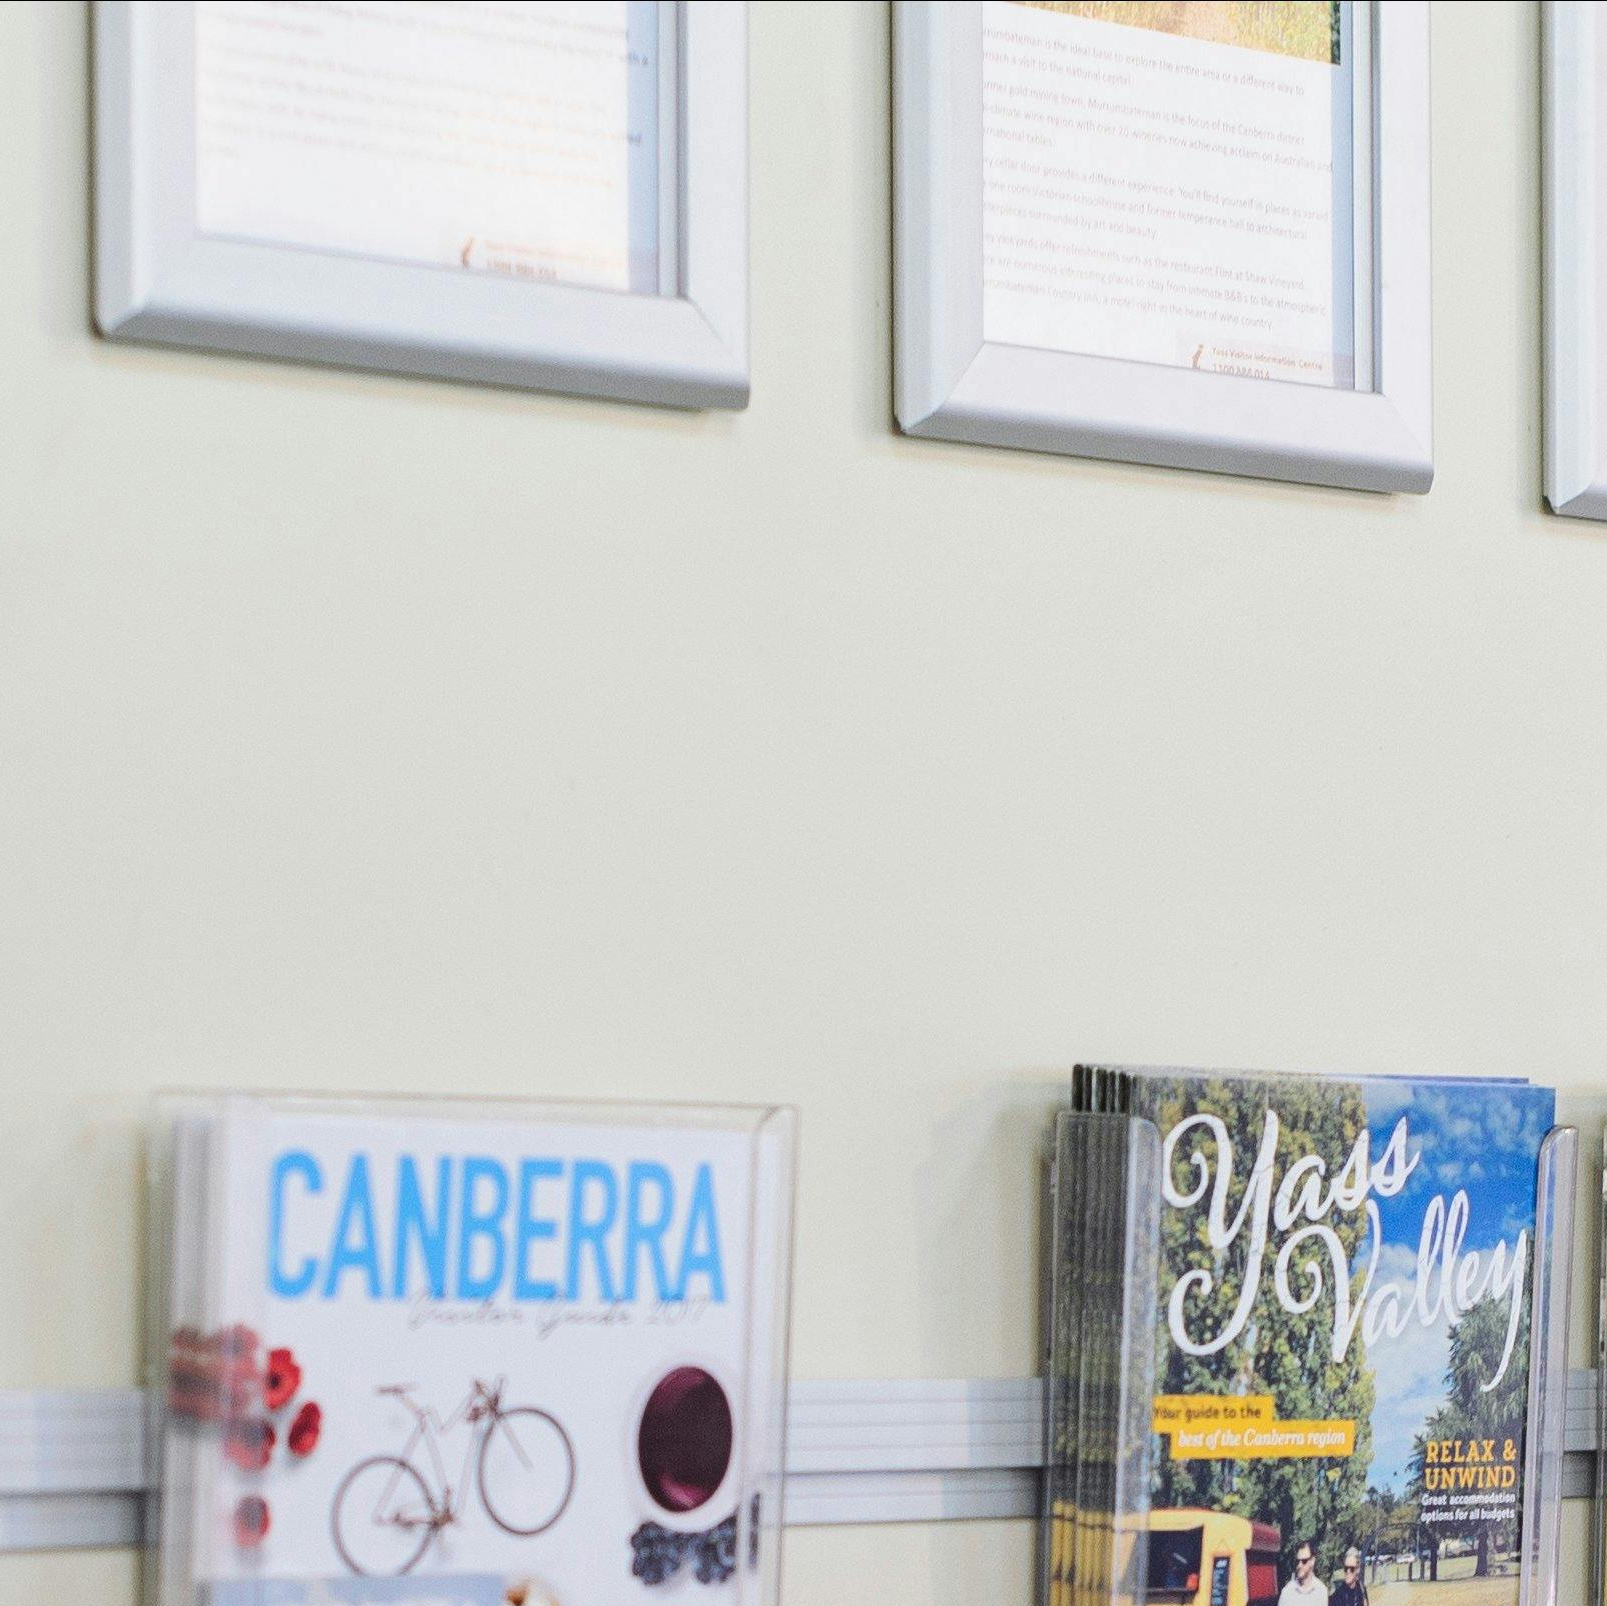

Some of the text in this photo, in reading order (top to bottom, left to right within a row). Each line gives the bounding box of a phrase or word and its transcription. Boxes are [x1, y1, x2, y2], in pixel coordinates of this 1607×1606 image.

[266, 1145, 728, 1304] CANBERRA
[1161, 1109, 1421, 1356] Yass
[1275, 1190, 1529, 1393] Valley
[1154, 1405, 1262, 1423] Your guide to the
[1178, 1428, 1346, 1450] best of the Canberra region
[1425, 1438, 1517, 1464] RELAX &
[1424, 1466, 1516, 1490] UNWIND
[1422, 1492, 1516, 1506] Great accommodation
[1421, 1507, 1515, 1523] options for all budgets
